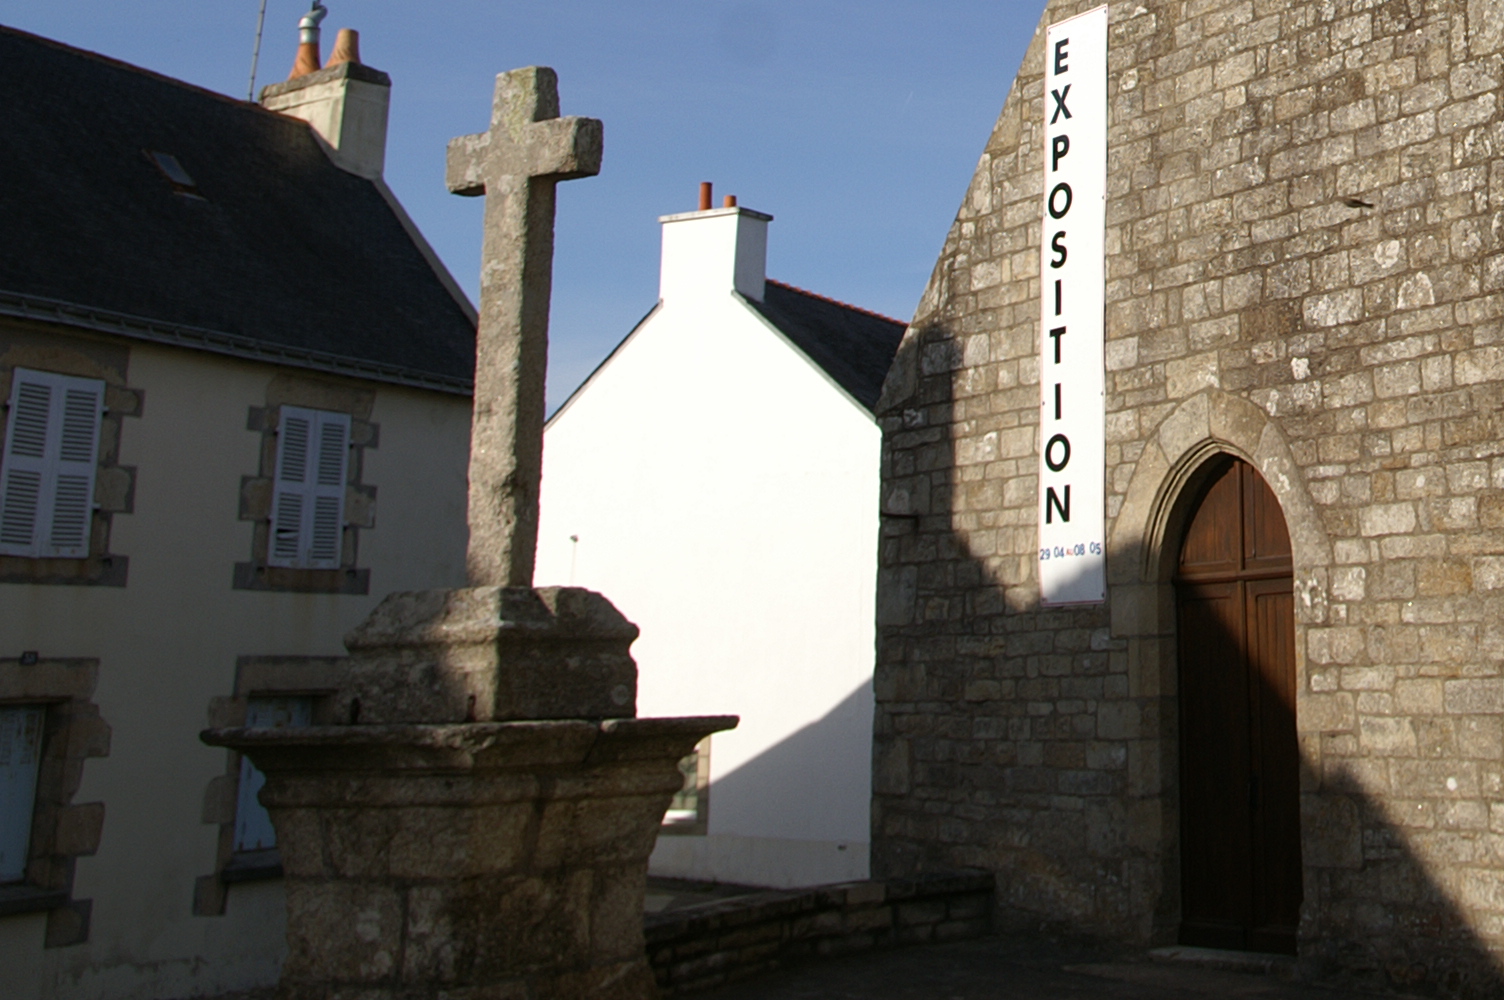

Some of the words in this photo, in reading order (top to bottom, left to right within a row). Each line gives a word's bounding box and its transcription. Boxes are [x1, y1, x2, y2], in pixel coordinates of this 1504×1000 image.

[1045, 37, 1073, 525] EXPOSITION
[1040, 548, 1050, 560] 29
[1054, 546, 1064, 558] 04
[1074, 543, 1085, 556] 08
[1090, 542, 1102, 555] 05
